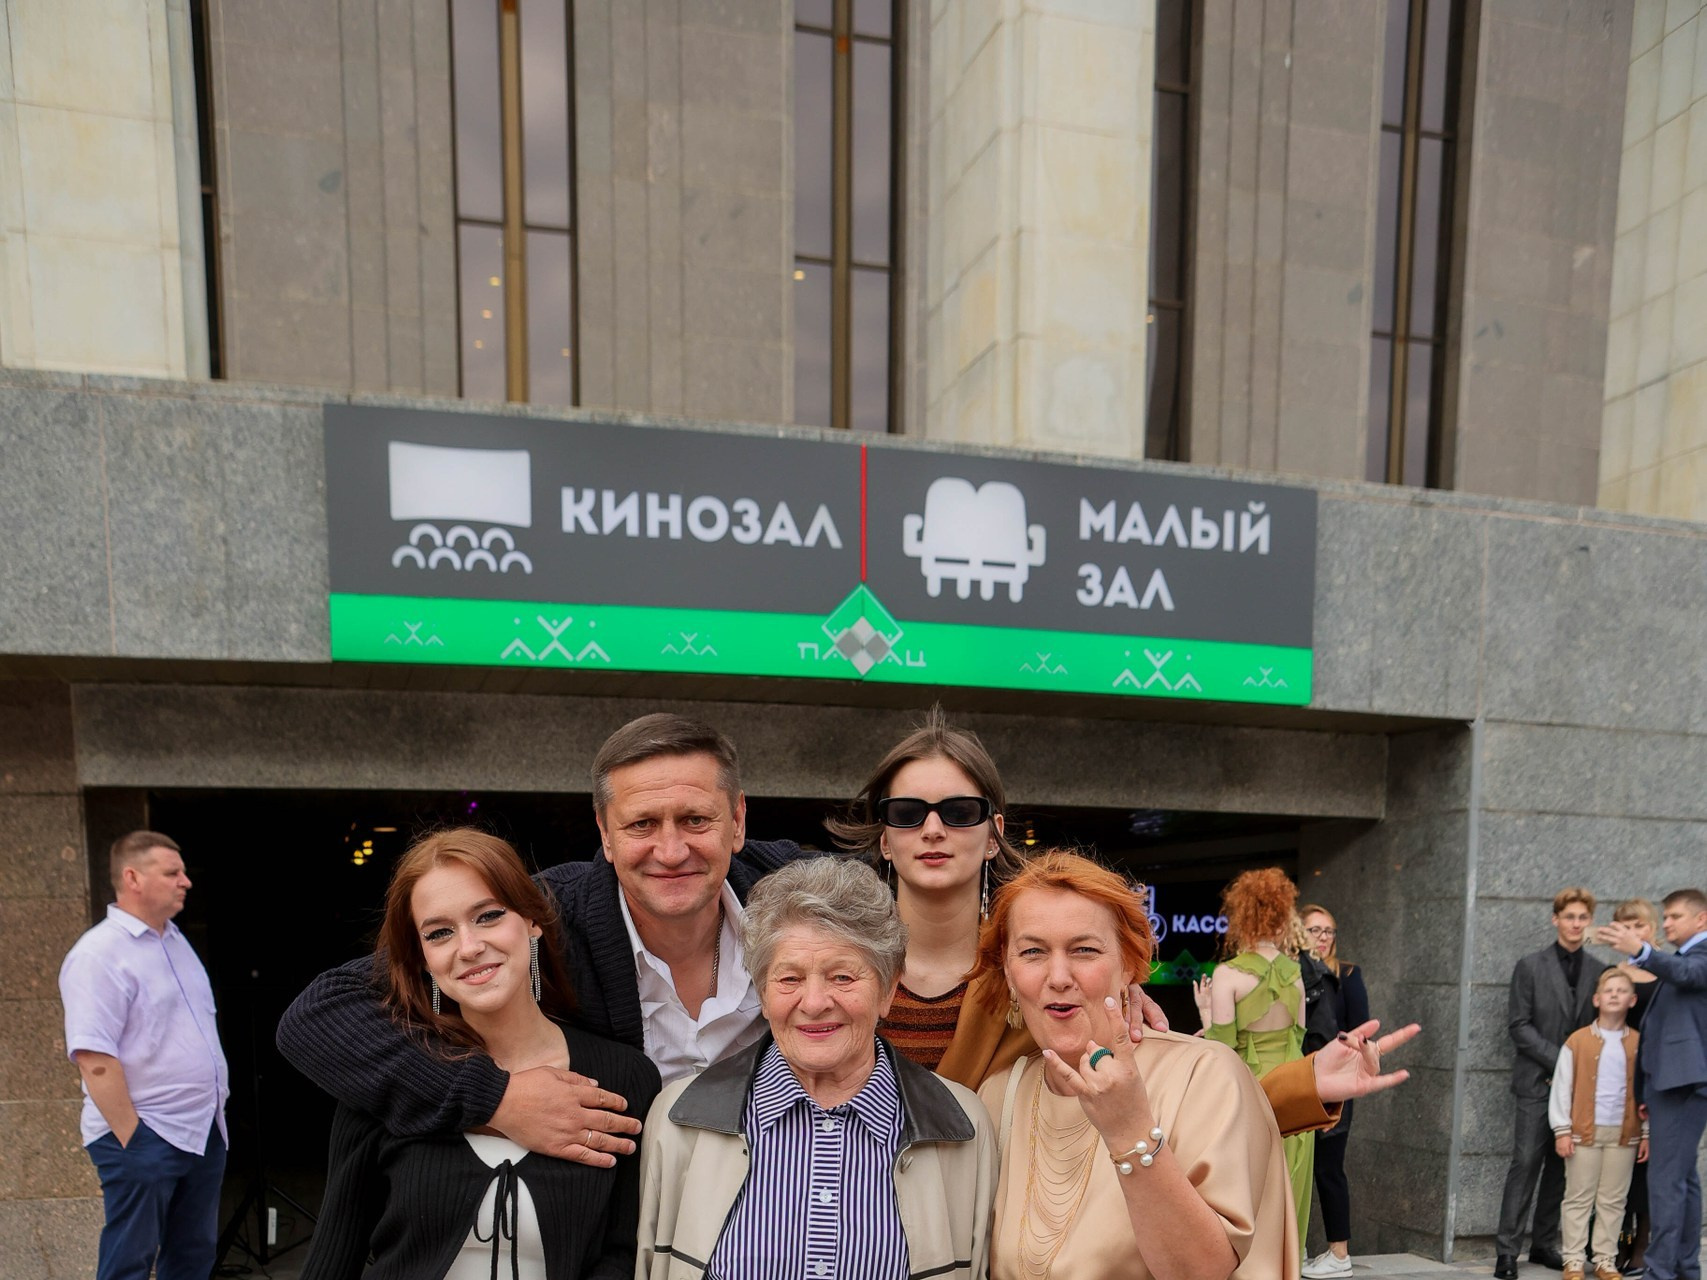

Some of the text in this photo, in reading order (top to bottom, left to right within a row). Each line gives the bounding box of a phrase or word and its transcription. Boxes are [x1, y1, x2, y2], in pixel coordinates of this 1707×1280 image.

[561, 486, 843, 549] КИНОЗАЛ
[1079, 497, 1271, 555] МАЛЫЙ
[1076, 563, 1175, 611] ЗАЛ
[1172, 914, 1229, 934] КАСС
